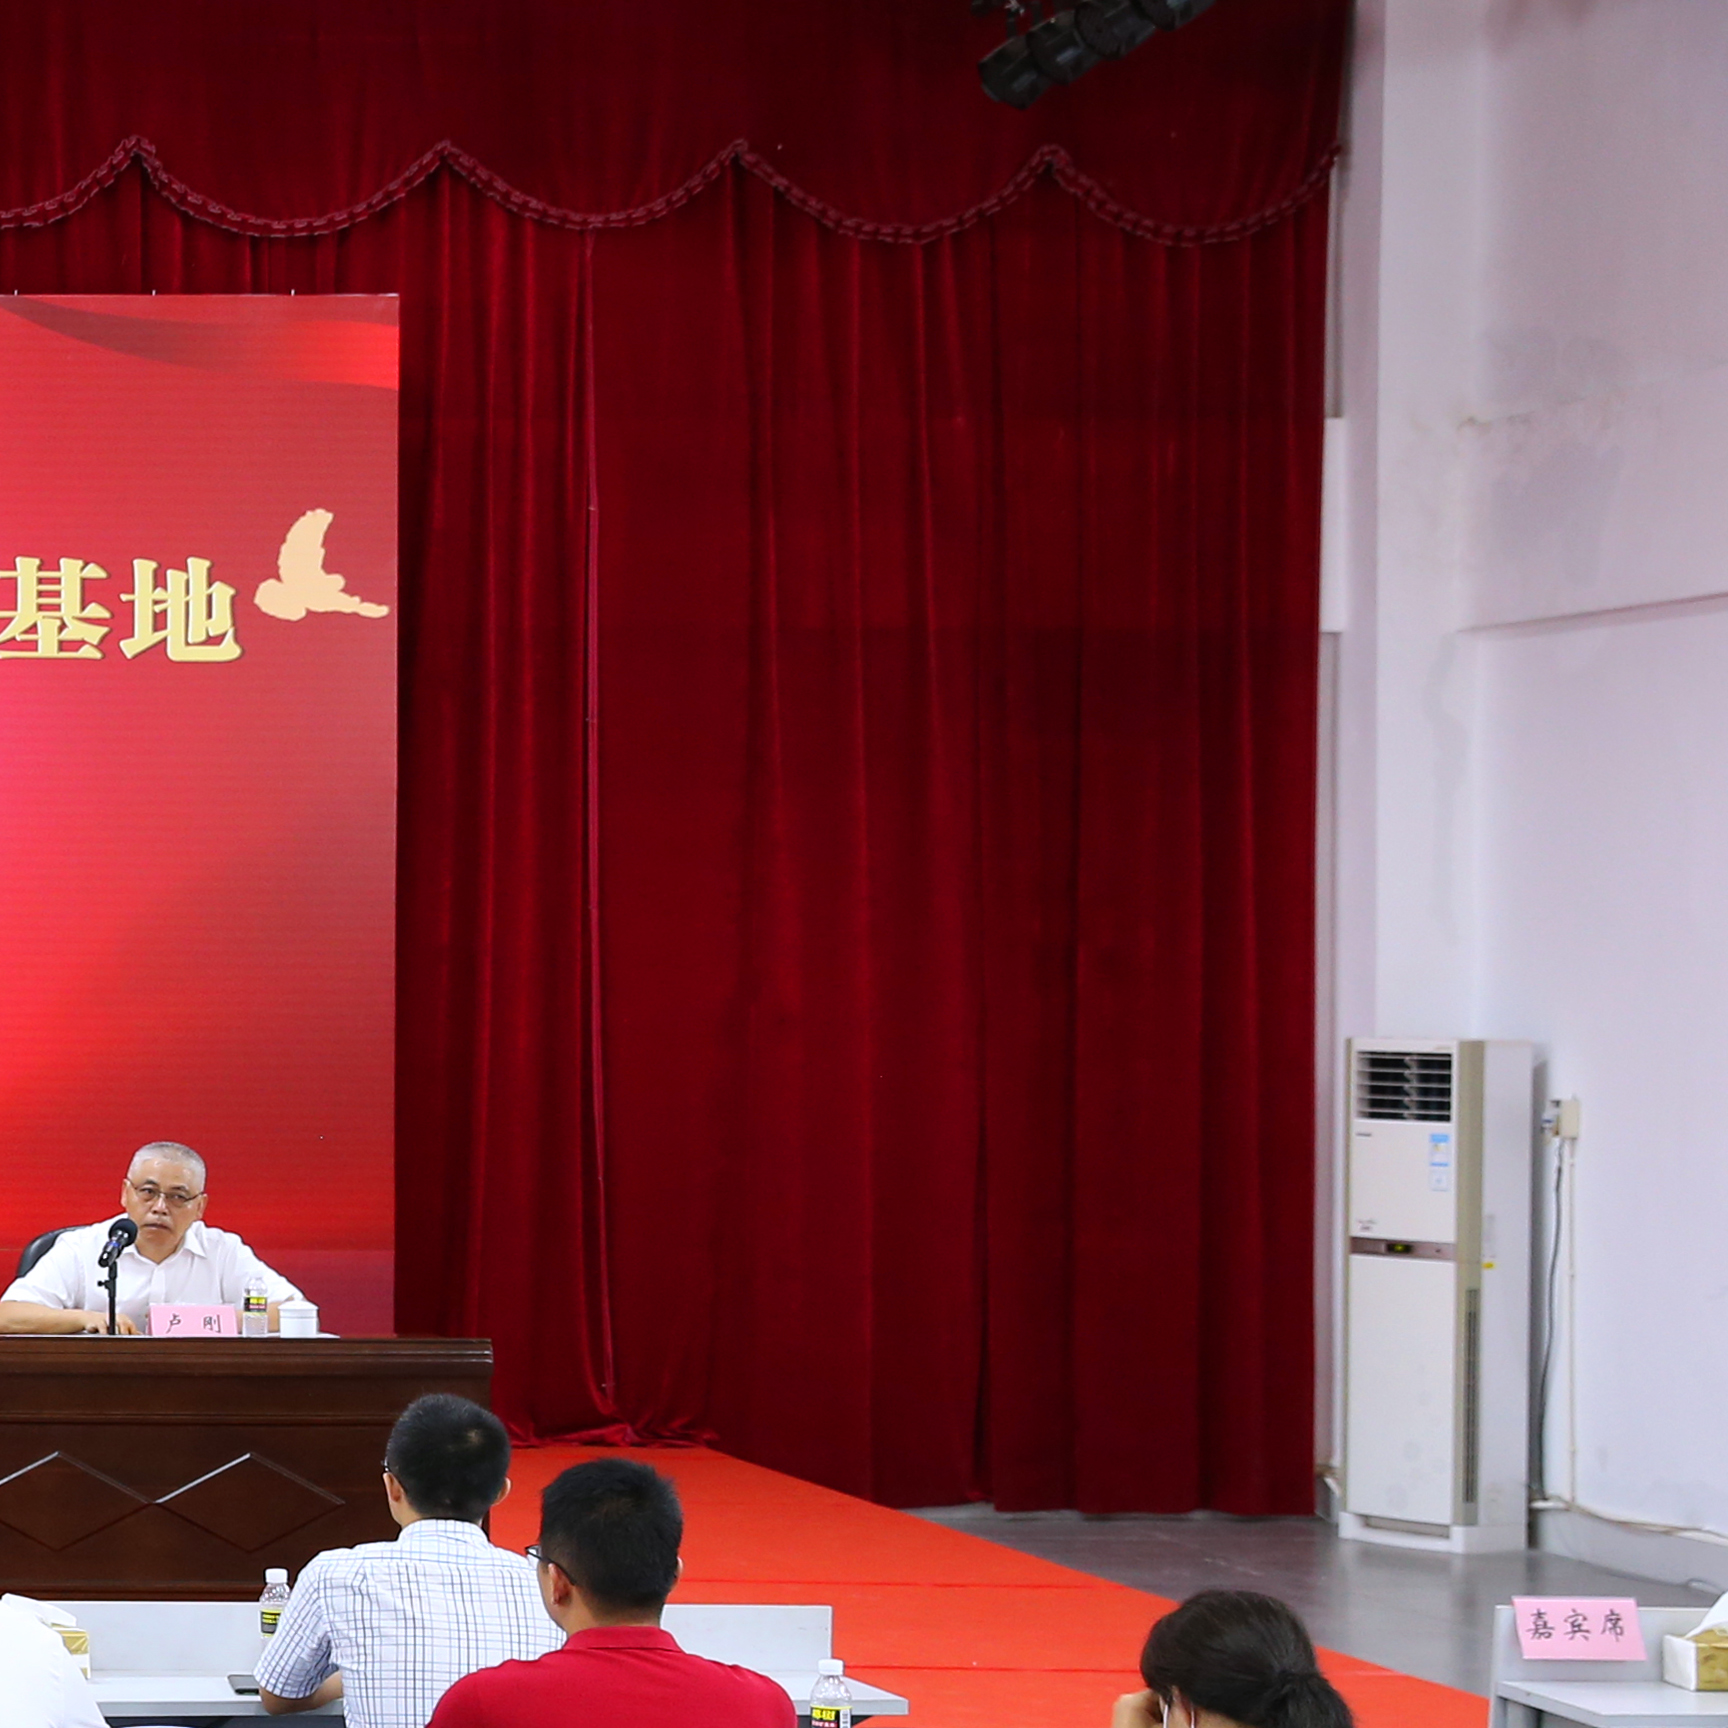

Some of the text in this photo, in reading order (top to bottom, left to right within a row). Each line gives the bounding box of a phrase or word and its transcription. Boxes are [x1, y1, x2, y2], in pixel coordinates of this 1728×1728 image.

[165, 1313, 222, 1335] 卢刚
[1526, 1607, 1626, 1642] 嘉宾席
